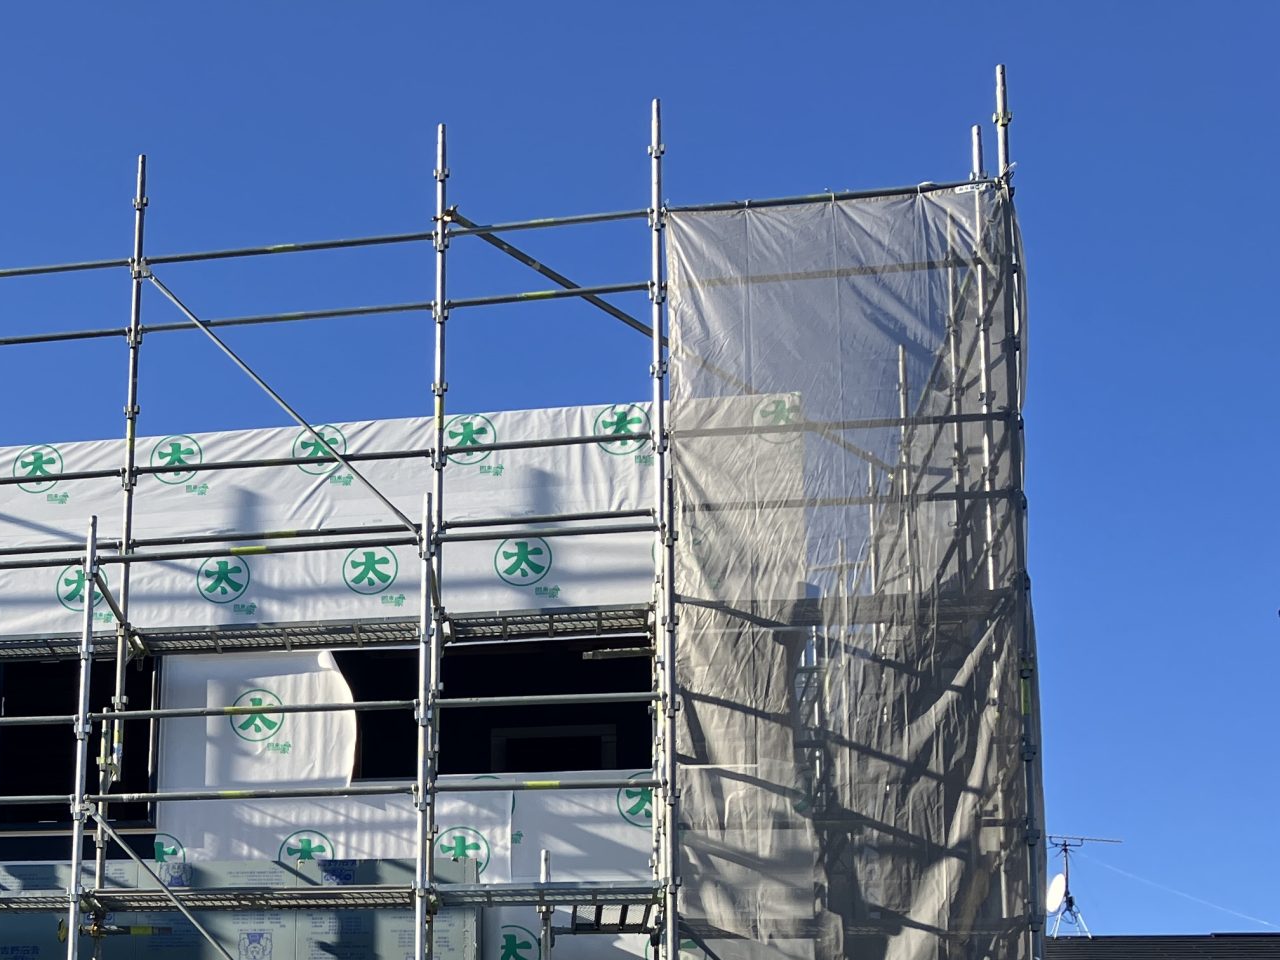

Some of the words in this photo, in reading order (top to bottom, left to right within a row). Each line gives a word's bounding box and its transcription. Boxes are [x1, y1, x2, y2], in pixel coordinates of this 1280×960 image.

[351, 552, 395, 587] 太
[503, 542, 546, 577] 太
[203, 561, 245, 595] 太
[239, 698, 278, 733] 太
